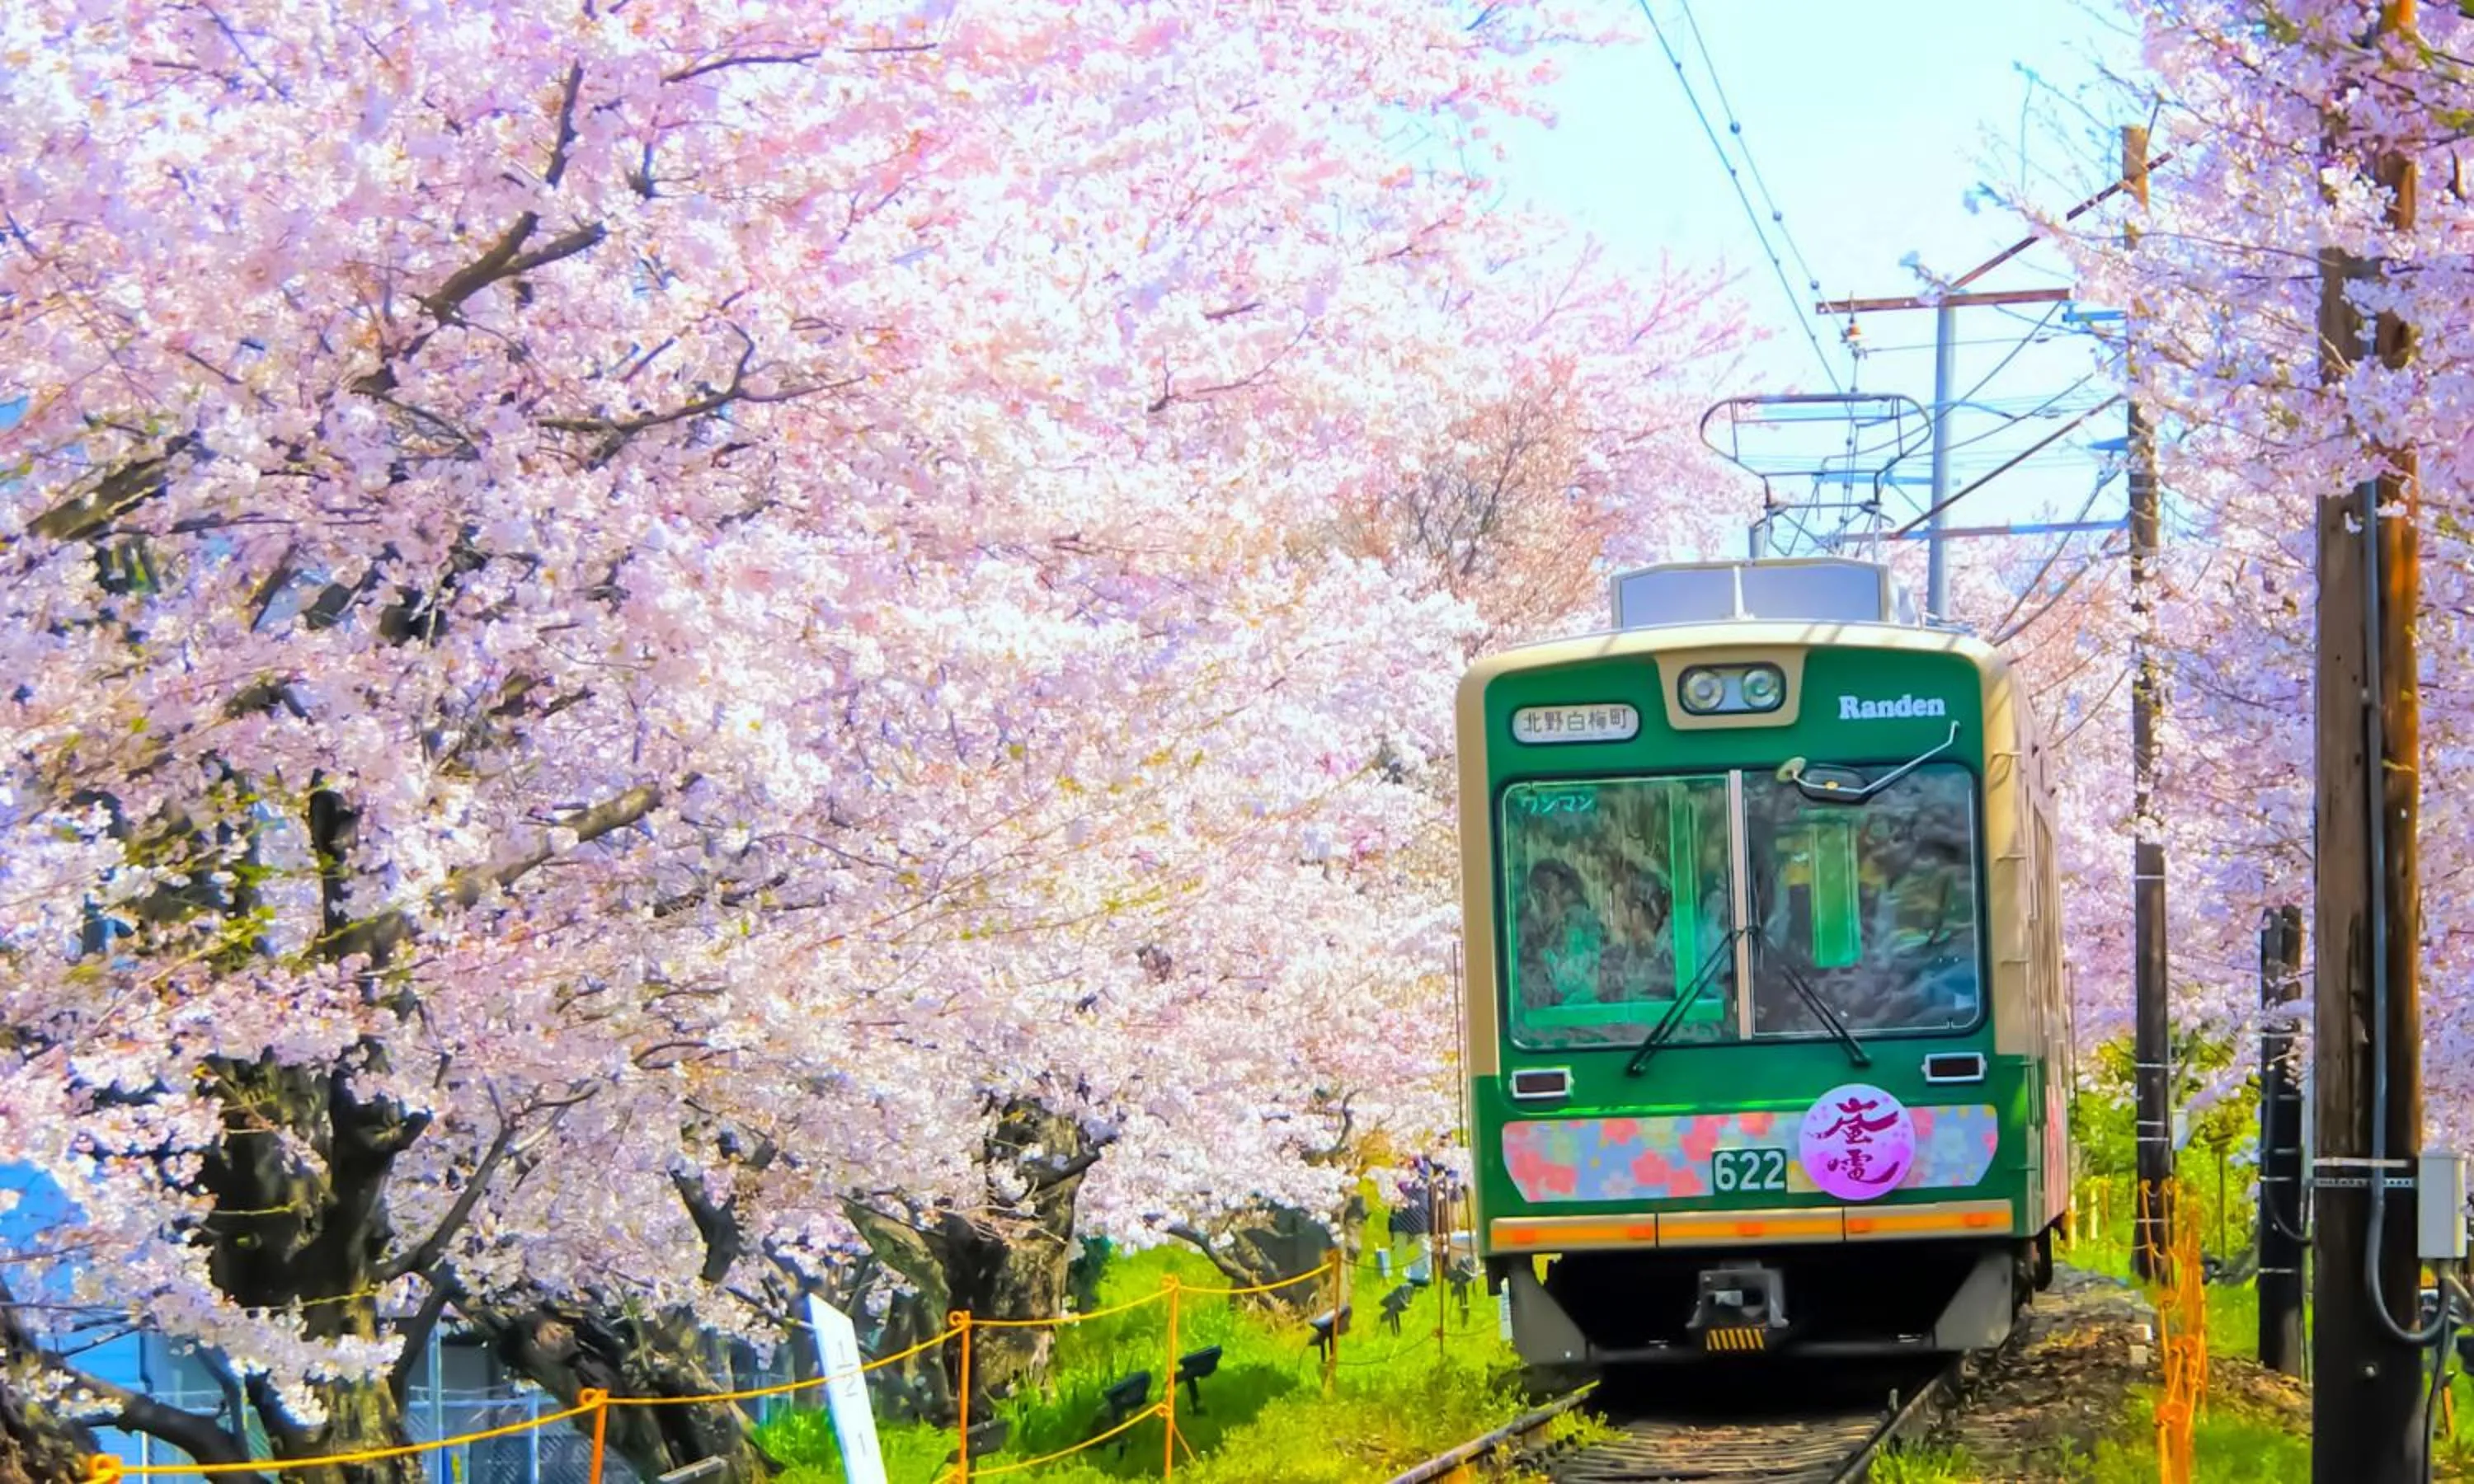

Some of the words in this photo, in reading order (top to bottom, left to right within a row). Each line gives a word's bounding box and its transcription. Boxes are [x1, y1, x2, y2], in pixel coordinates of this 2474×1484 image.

[1838, 693, 1945, 720] Randen
[1523, 708, 1627, 733] 北野白梅町
[1521, 795, 1592, 815] ワンマン
[1714, 1152, 1785, 1190] 622
